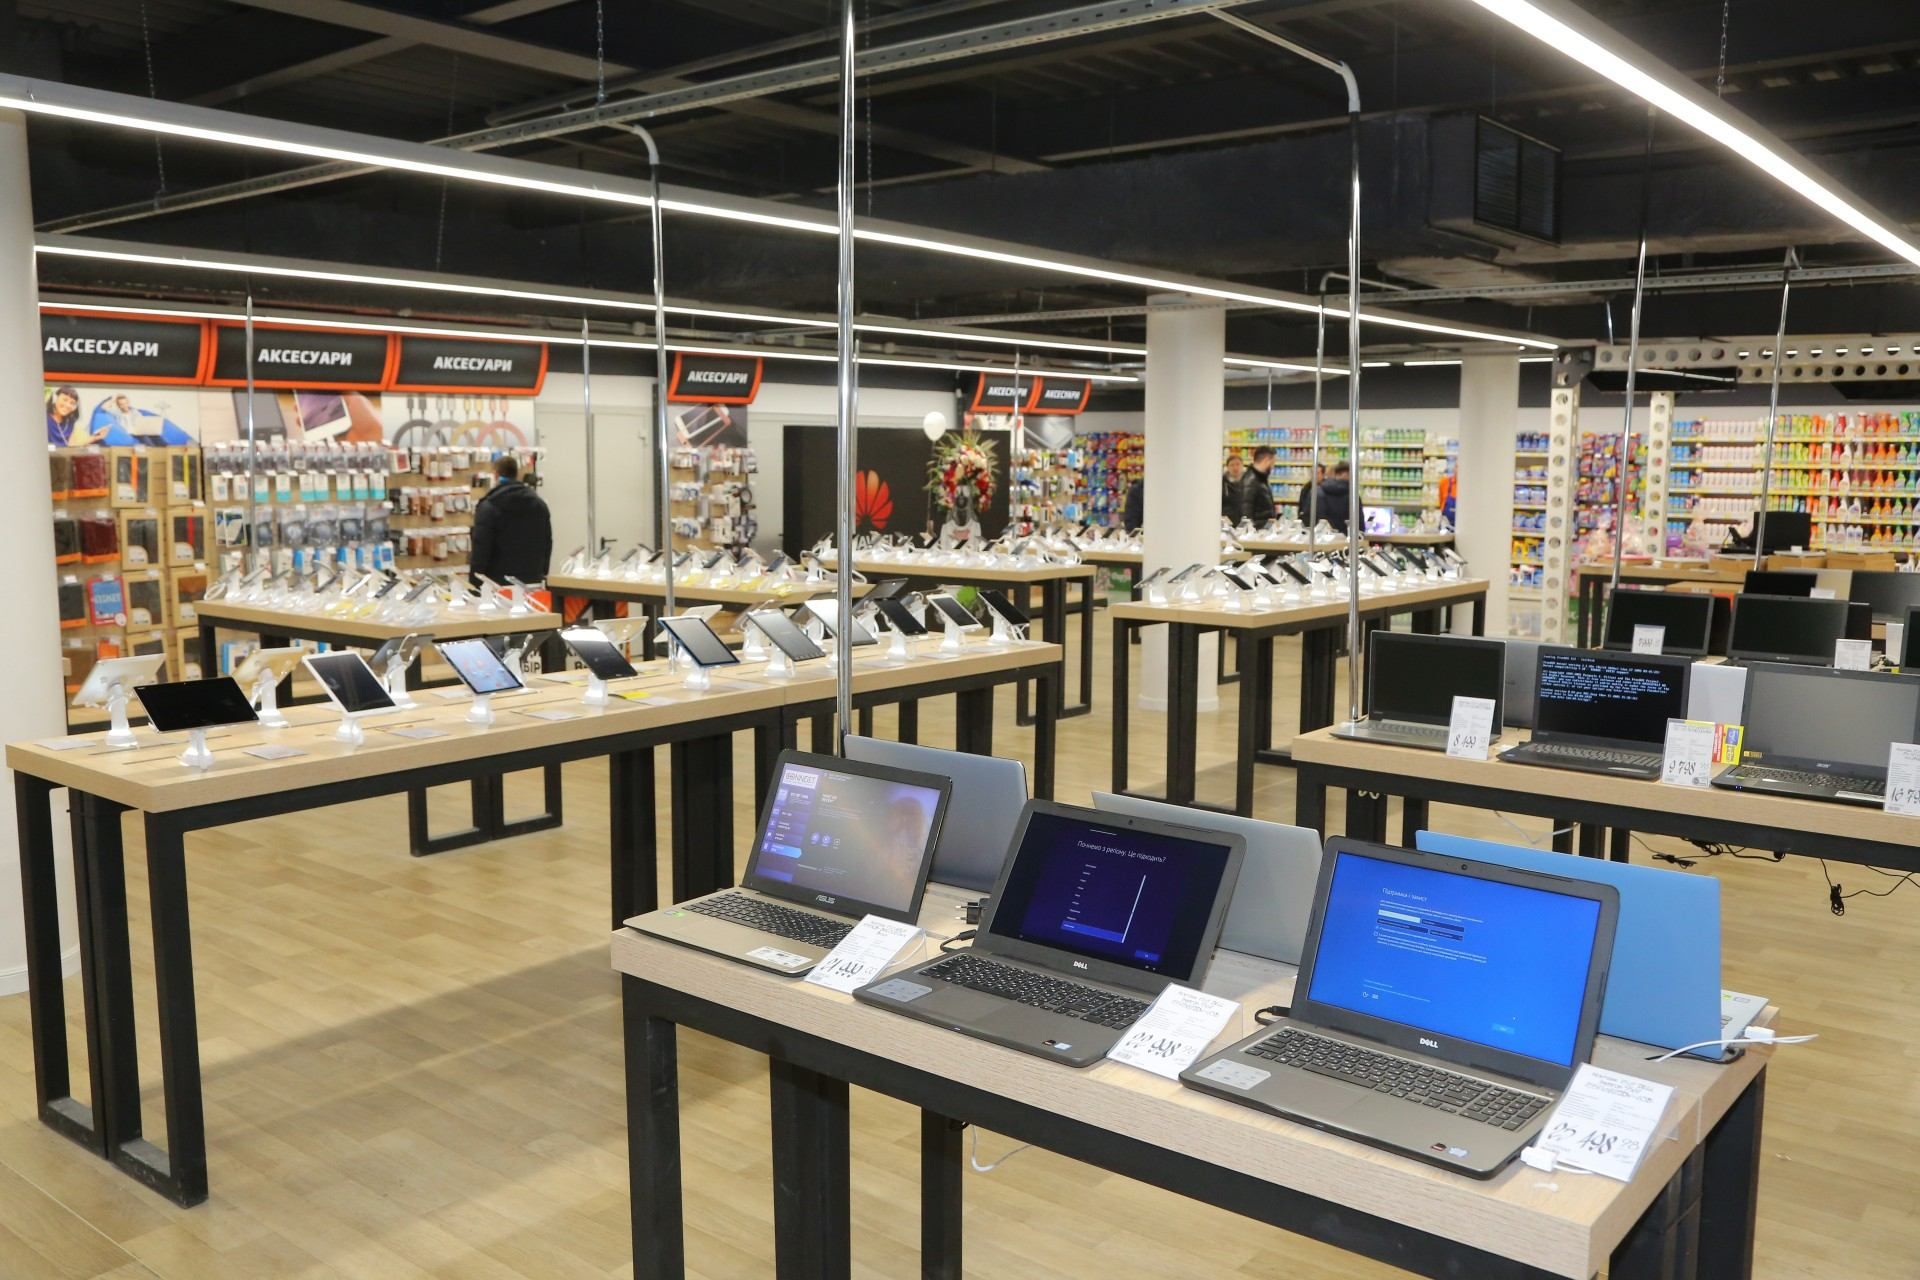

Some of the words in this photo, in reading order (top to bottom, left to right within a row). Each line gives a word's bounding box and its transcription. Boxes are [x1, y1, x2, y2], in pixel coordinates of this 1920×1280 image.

[44, 335, 159, 358] АКСЕСУАРИ
[258, 348, 353, 366] АКСЕСУАРИ
[433, 355, 513, 372] АКСЕСУАРИ
[687, 369, 749, 385] АКСЕСУАРИ
[815, 894, 836, 905] ASUS
[1073, 960, 1089, 970] DELL
[1419, 1037, 1439, 1049] DELL
[1578, 1129, 1618, 1155] 498
